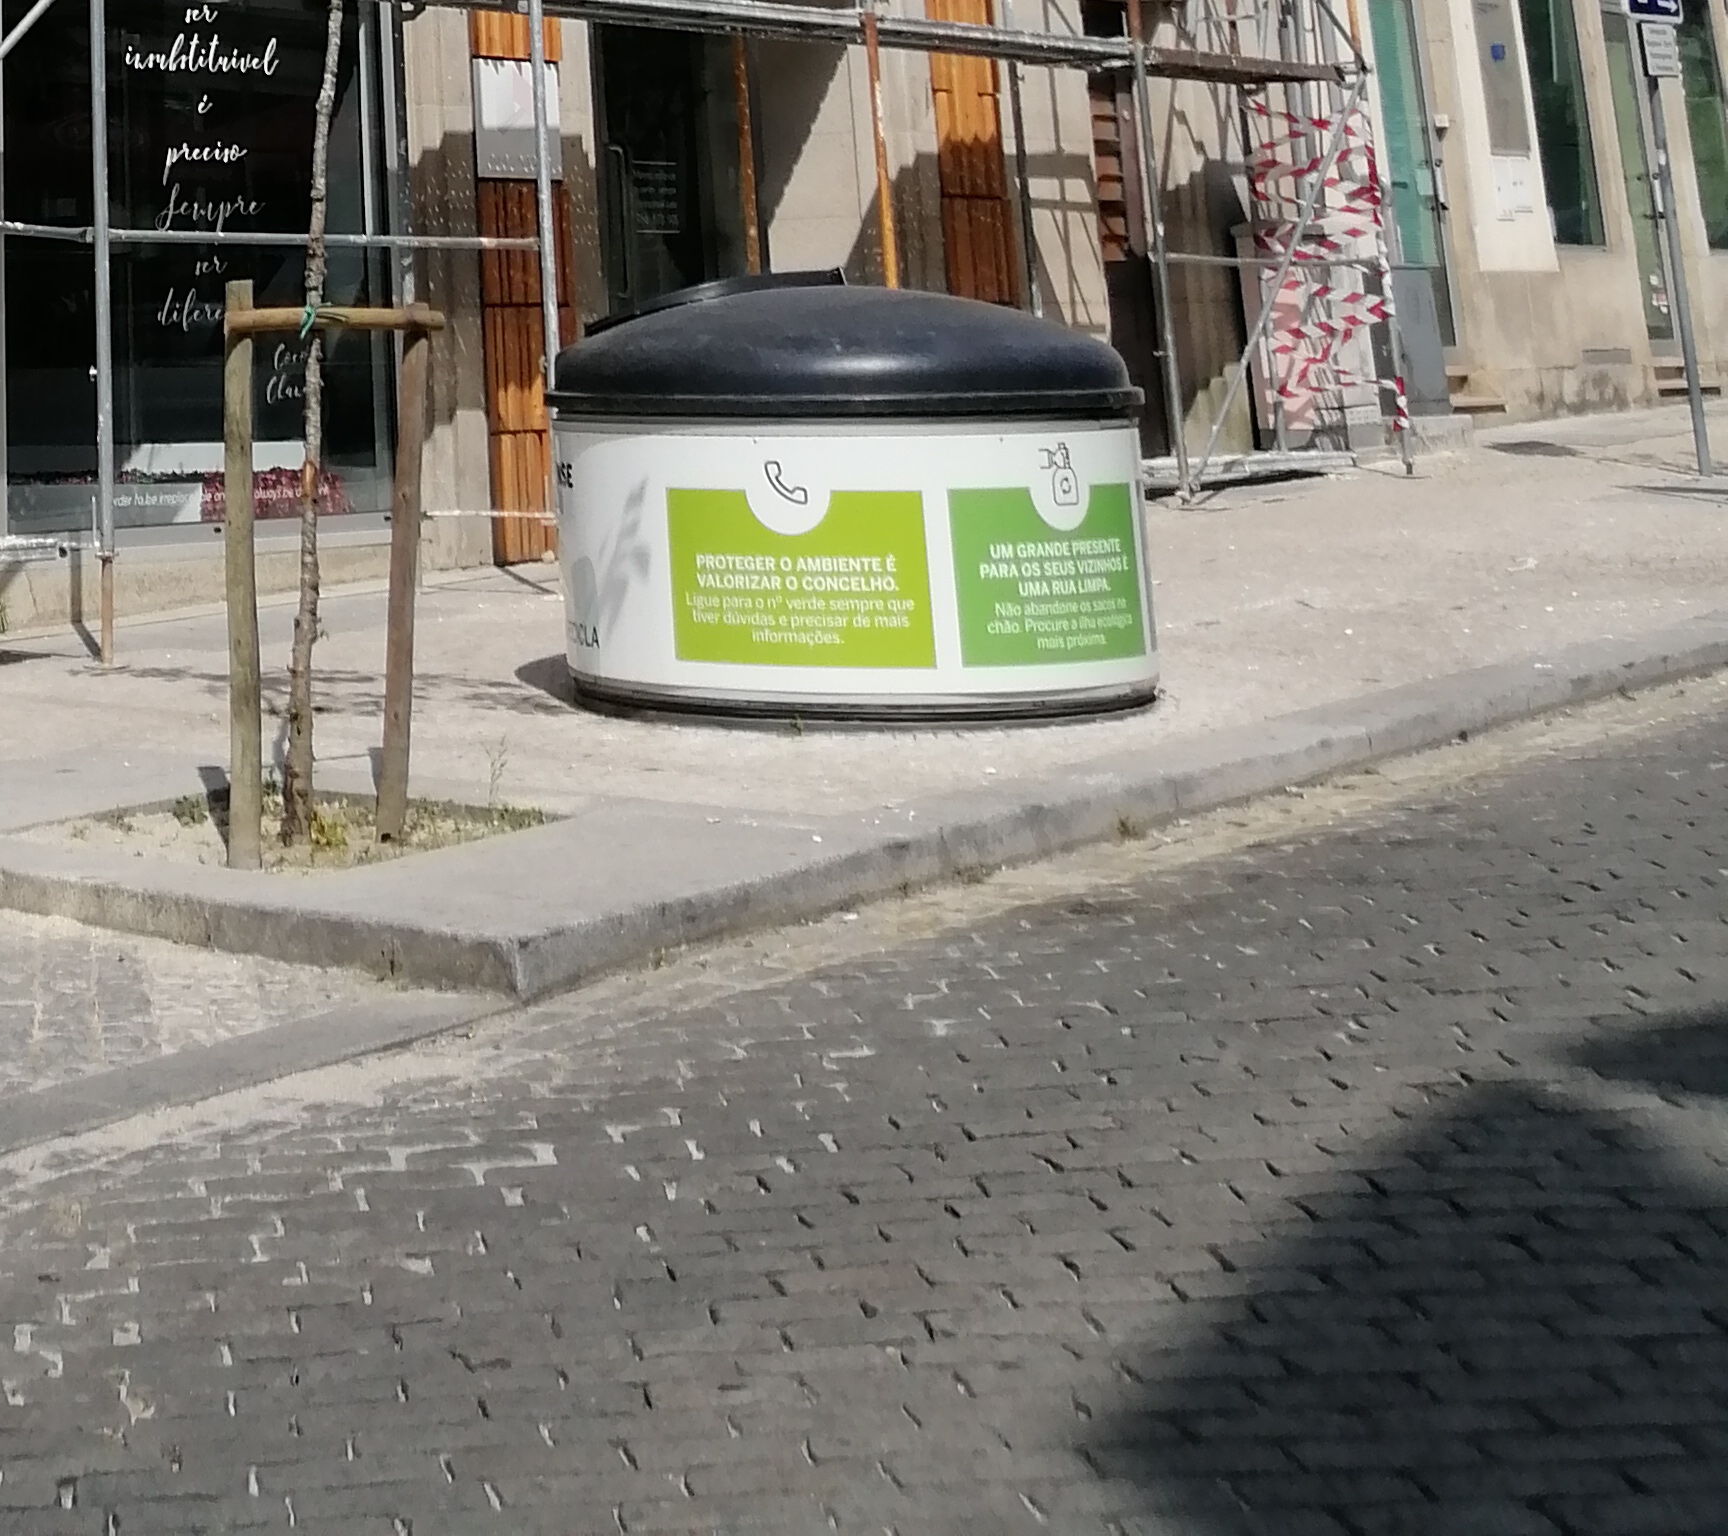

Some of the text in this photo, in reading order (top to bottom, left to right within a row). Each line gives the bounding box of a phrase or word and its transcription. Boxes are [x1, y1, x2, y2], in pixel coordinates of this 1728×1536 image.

[162, 140, 248, 186] preciso
[157, 287, 225, 332] difere
[989, 538, 1121, 559] UM GRANDE PRESENTE
[695, 552, 896, 573] PROTEGER O AMBIENTE É
[979, 564, 1019, 579] PARA
[1021, 562, 1041, 577] OS
[1044, 561, 1076, 576] SEUS
[1076, 556, 1122, 574] VIZINHOS
[696, 573, 899, 592] VALORIZAR O CONCELHO.
[1018, 577, 1111, 596] UMA RUA LIMPA.
[685, 592, 720, 610] Ligue
[723, 596, 752, 612] para
[755, 598, 764, 609] o
[785, 596, 825, 610] verde
[829, 599, 883, 613] sempre
[887, 600, 915, 614] que
[995, 601, 1022, 617] Não
[1024, 601, 1078, 615] abandone
[692, 609, 910, 630] tiver dúvidas e precisar de mais
[1025, 617, 1069, 633] Procure
[752, 628, 845, 647] informações.
[1037, 634, 1064, 649] mais
